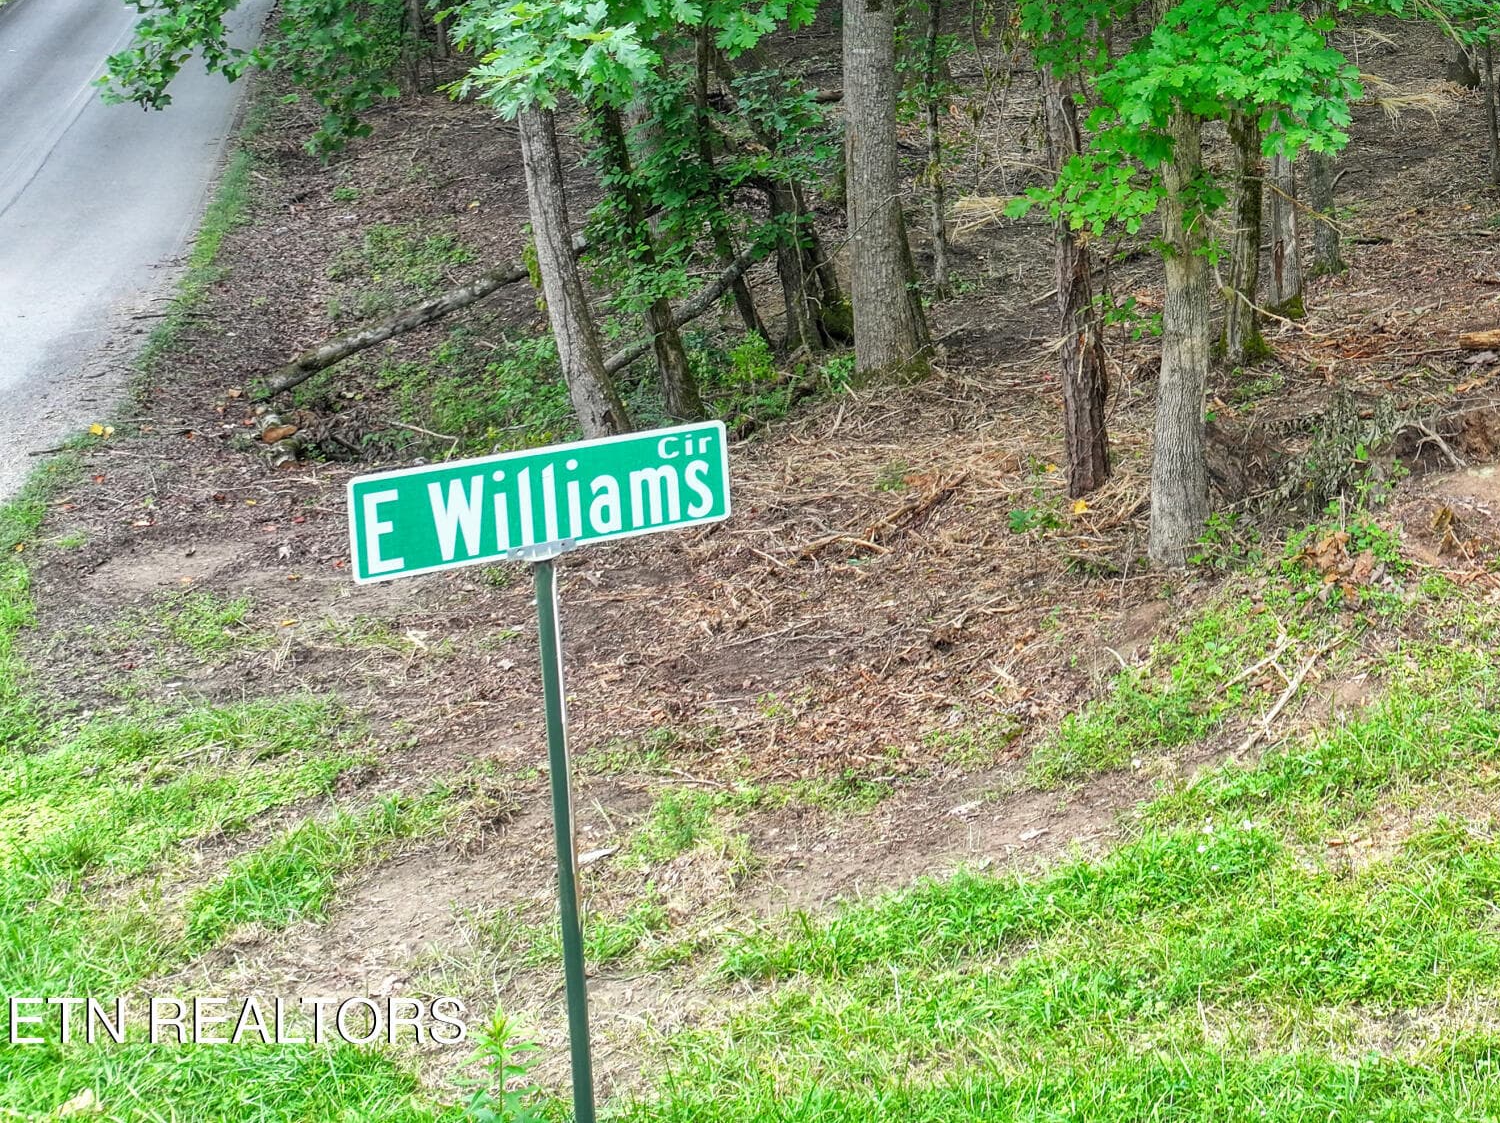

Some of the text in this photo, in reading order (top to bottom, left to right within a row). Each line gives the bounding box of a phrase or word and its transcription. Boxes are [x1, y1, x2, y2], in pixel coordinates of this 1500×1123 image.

[657, 433, 713, 460] Cir
[363, 459, 714, 575] E Williams
